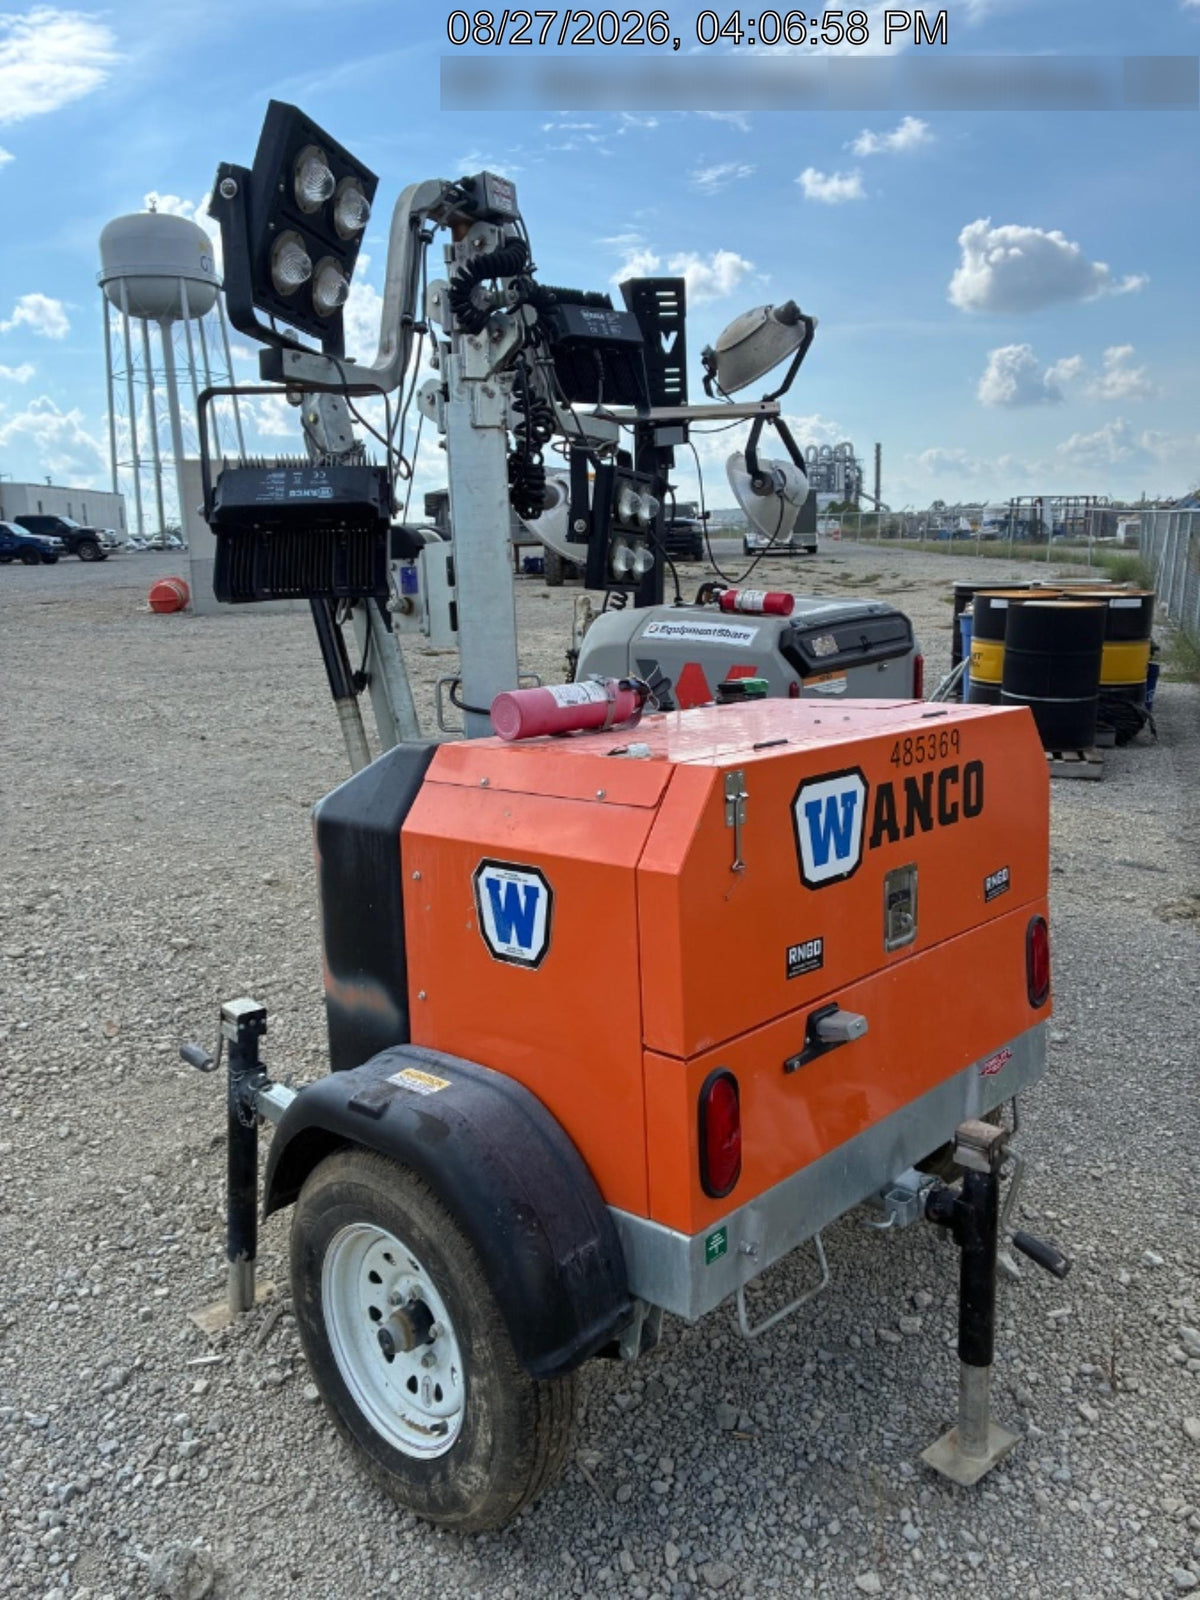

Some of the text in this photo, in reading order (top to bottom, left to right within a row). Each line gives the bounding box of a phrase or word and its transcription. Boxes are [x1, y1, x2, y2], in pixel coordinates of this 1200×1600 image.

[659, 624, 751, 641] EquipmentShare
[890, 728, 960, 768] 485369
[486, 876, 540, 950] W
